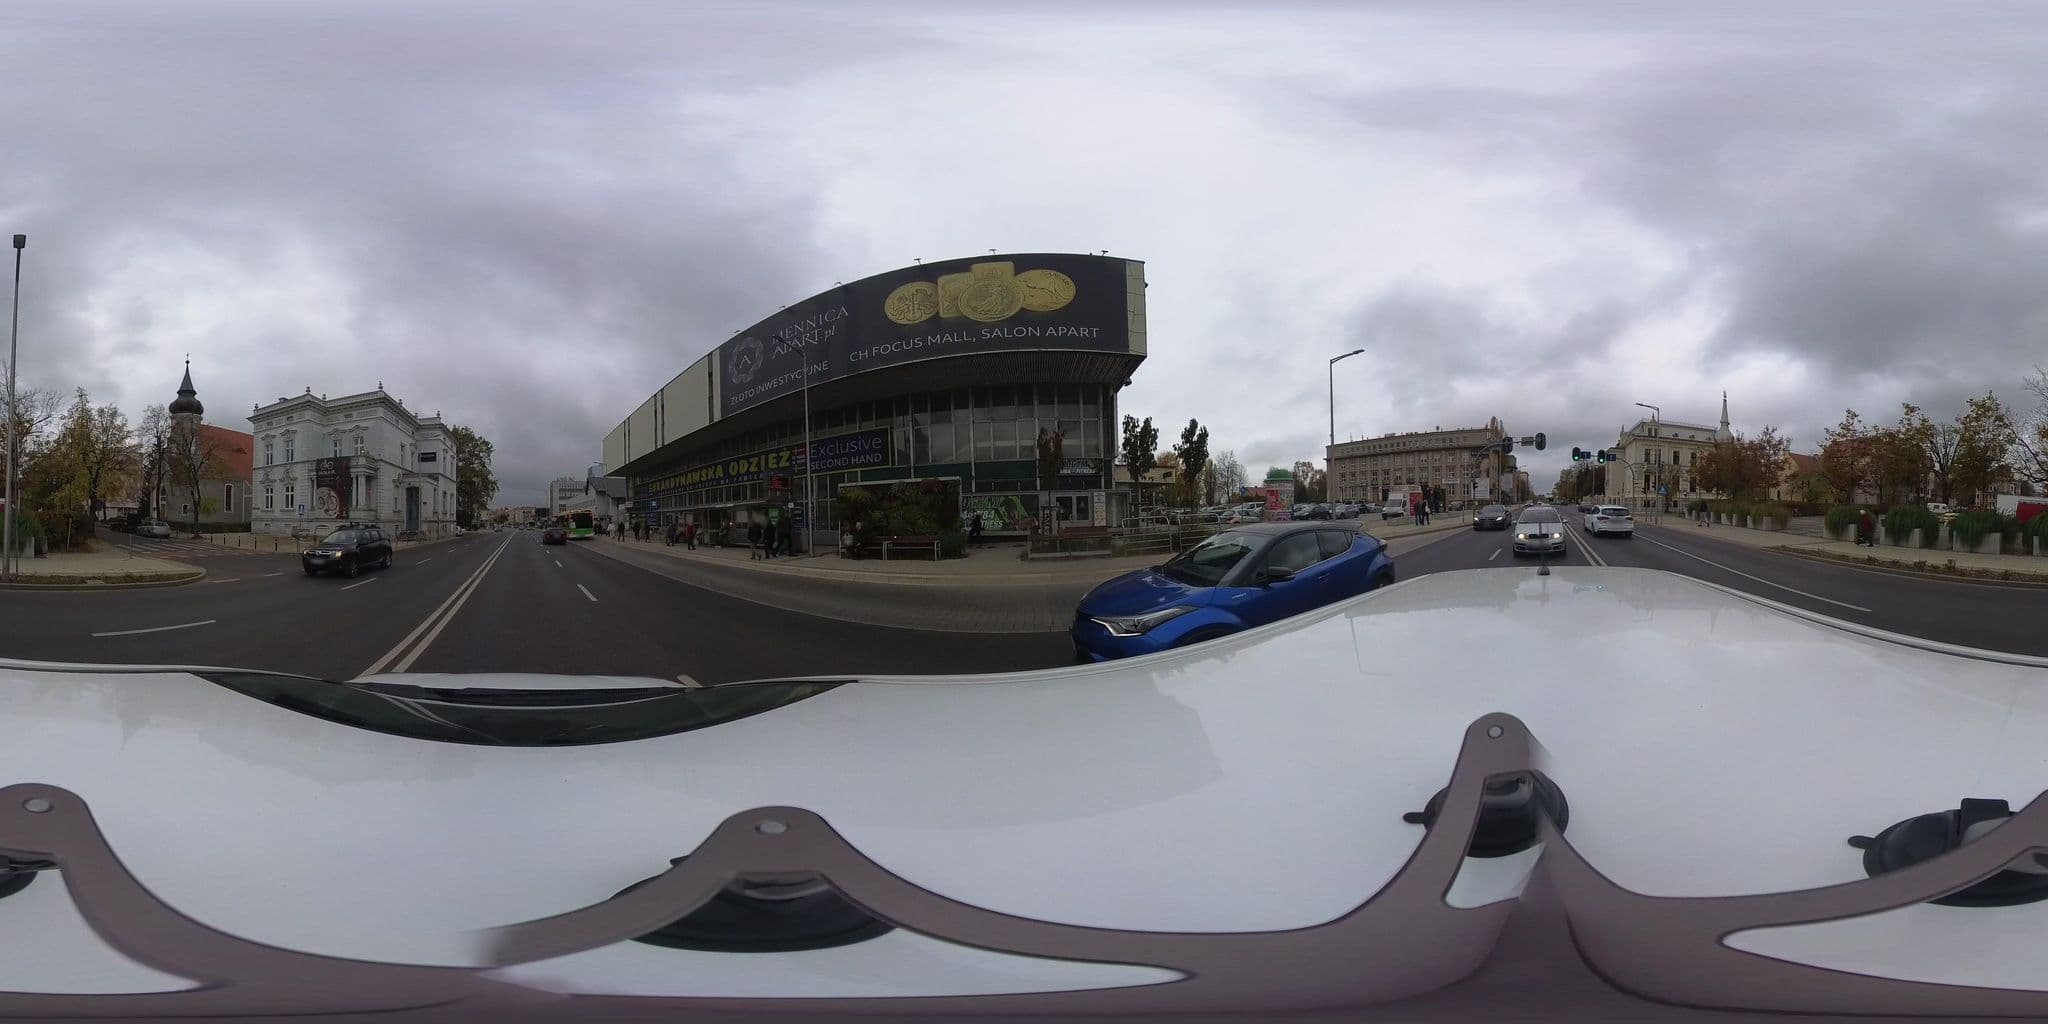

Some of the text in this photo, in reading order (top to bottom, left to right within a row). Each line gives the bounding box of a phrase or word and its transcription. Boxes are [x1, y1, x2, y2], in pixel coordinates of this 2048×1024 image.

[772, 306, 849, 344] MENNICA
[850, 326, 1101, 362] CH FOCUS MALL, SALON APART
[731, 361, 829, 406] ZŁOTO INWESTYCYJNE
[729, 448, 792, 476] ODZIEŻ
[810, 437, 881, 458] Exclusive
[810, 453, 882, 471] SECOND HAND
